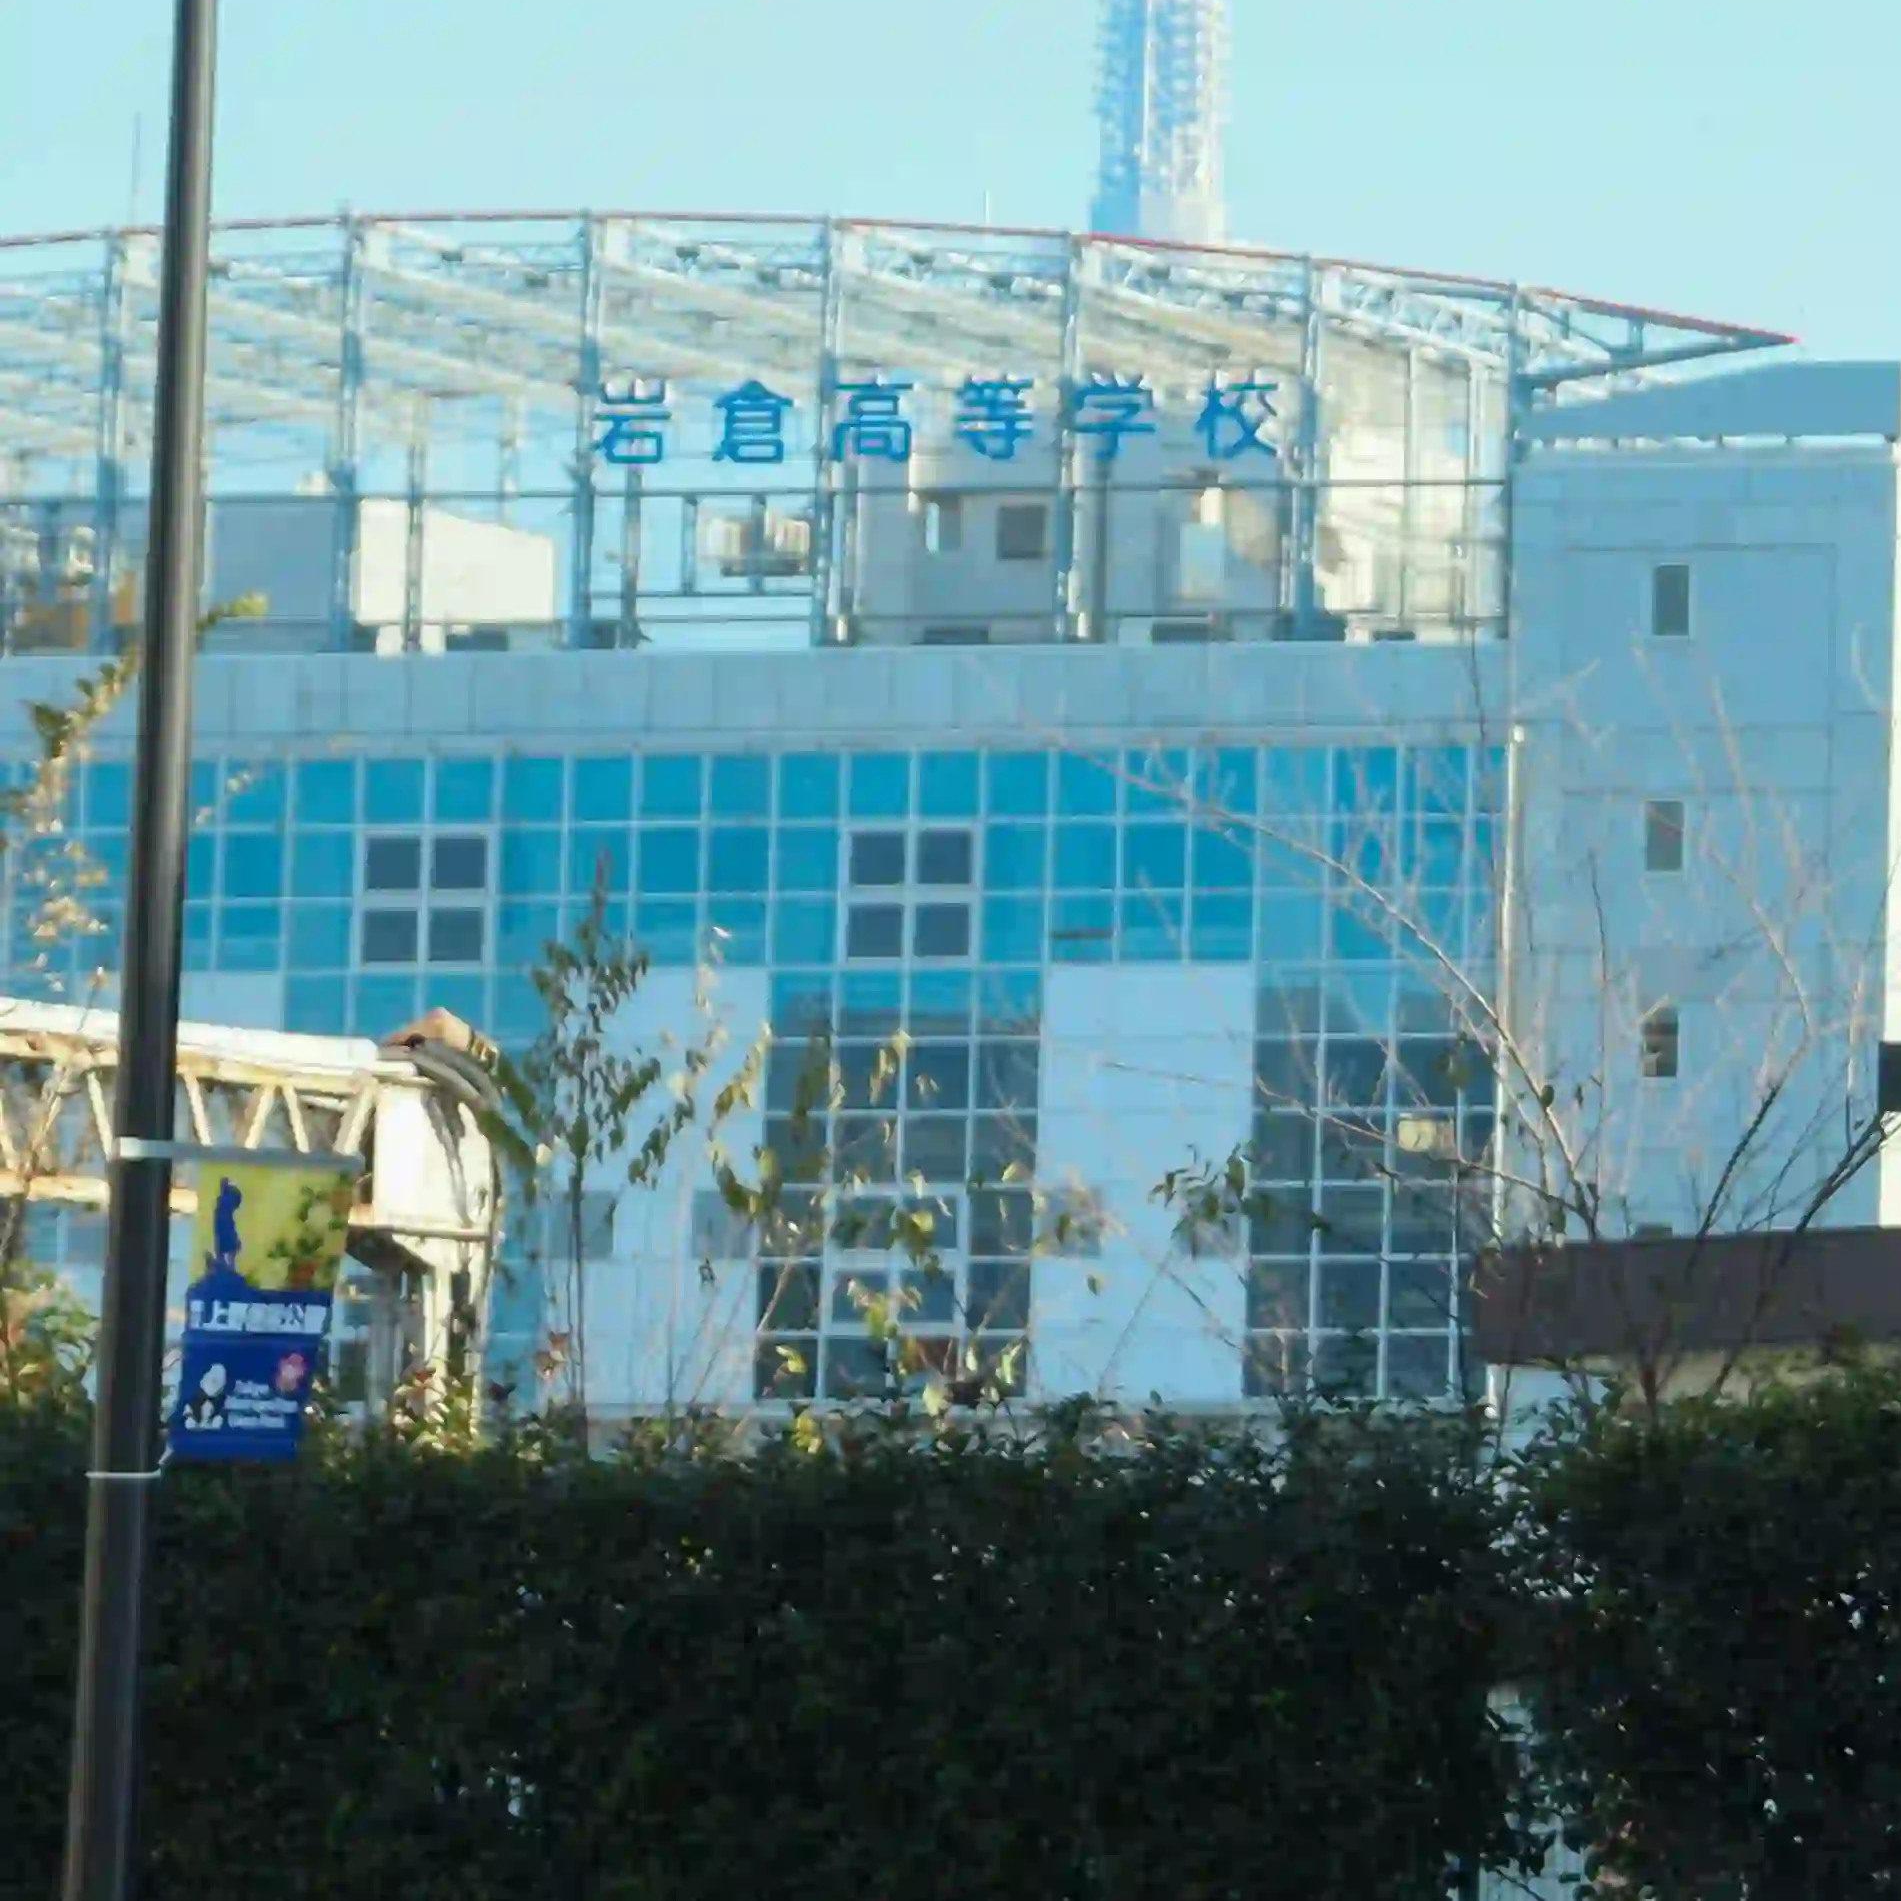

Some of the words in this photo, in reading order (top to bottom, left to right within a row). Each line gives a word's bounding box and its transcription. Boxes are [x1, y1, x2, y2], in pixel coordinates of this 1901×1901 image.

[590, 368, 1282, 466] 岩倉高等学校
